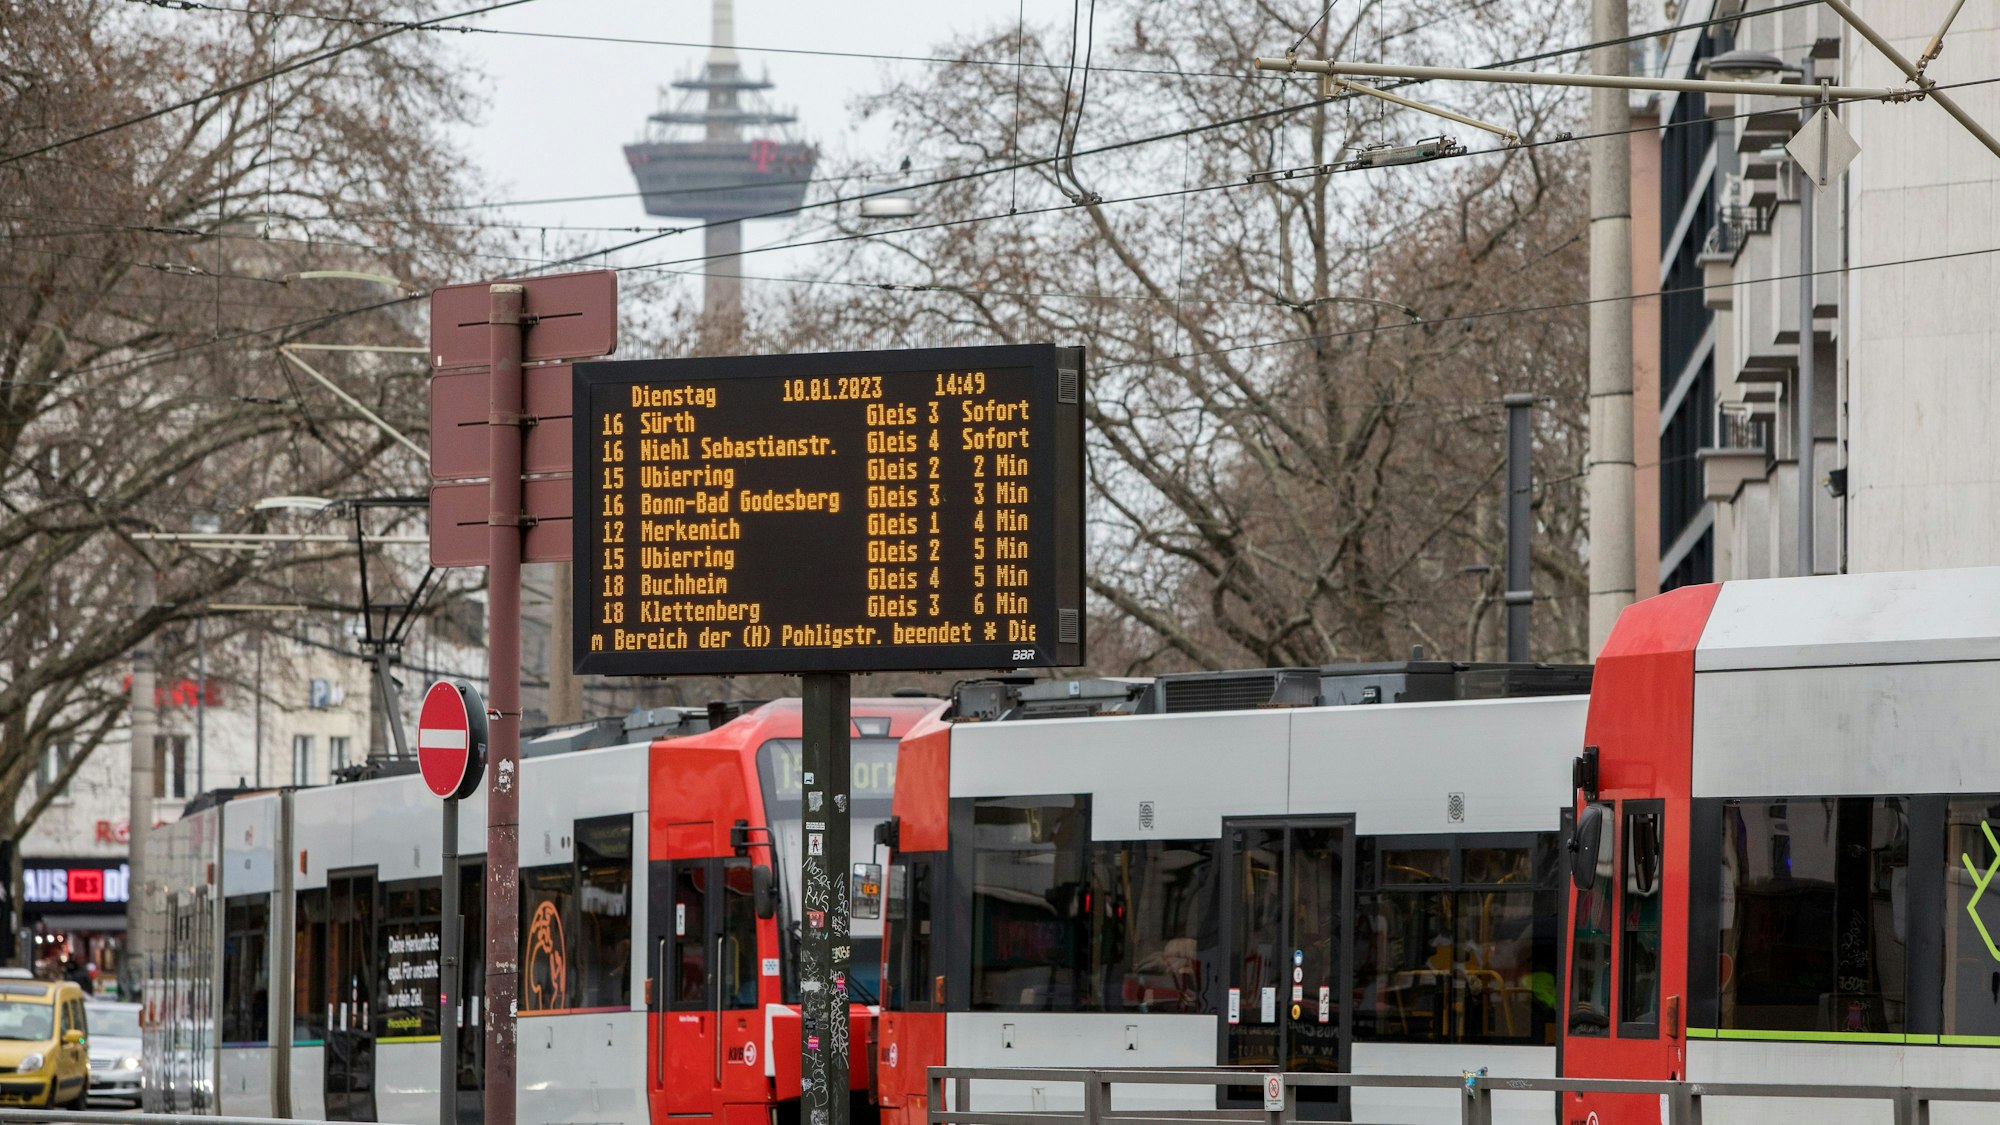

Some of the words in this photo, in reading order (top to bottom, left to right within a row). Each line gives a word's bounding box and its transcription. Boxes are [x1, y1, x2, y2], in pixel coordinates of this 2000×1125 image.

[632, 386, 717, 408] Dienstag
[783, 377, 883, 402] 10.01.2023
[935, 373, 985, 396] 14:49
[602, 414, 624, 436] 16
[640, 411, 695, 434] Sürth
[866, 403, 917, 426] Gleis
[928, 402, 939, 424] 3
[962, 400, 1029, 423] Sofort
[602, 441, 624, 463] 16
[640, 438, 690, 461] Niehl
[701, 435, 837, 459] Sebastianstr.
[867, 431, 917, 454] Gleis
[928, 429, 940, 451] 4
[962, 427, 1029, 450] Sofort
[602, 467, 624, 489] 15
[641, 465, 734, 489] Ubierring
[867, 458, 918, 481] Gleis
[929, 457, 940, 479] 2
[974, 455, 985, 478] 2
[996, 454, 1028, 477] Min
[602, 495, 624, 516] 16
[641, 491, 729, 515] Bonn-Bad
[740, 489, 840, 513] Godesberg
[867, 486, 918, 509] Gleis
[929, 484, 940, 506] 3
[974, 483, 985, 505] 3
[996, 482, 1028, 504] Min
[602, 521, 624, 543] 12
[641, 518, 740, 542] Merkenich
[867, 513, 918, 536] Gleis
[929, 512, 940, 534] 1
[974, 511, 985, 532] 4
[996, 510, 1028, 532] Min
[602, 548, 624, 570] 15
[641, 546, 735, 570] Ubierring
[867, 540, 918, 563] Gleis
[929, 539, 940, 561] 2
[974, 538, 985, 560] 5
[996, 537, 1028, 559] Min
[602, 575, 624, 597] 18
[641, 573, 728, 596] Buchheim
[868, 568, 918, 590] Gleis
[929, 567, 940, 589] 4
[974, 566, 985, 588] 5
[996, 565, 1028, 587] Min
[602, 602, 624, 624] 18
[640, 600, 760, 624] Klettenberg
[867, 595, 917, 618] Gleis
[929, 594, 940, 616] 3
[974, 593, 985, 615] 6
[996, 593, 1028, 615] Min
[614, 628, 688, 651] Bereich
[699, 627, 732, 649] der
[743, 626, 771, 648] (H)
[782, 624, 882, 649] Pohligstr.
[893, 622, 972, 645] beendet
[1012, 650, 1035, 660] BBR
